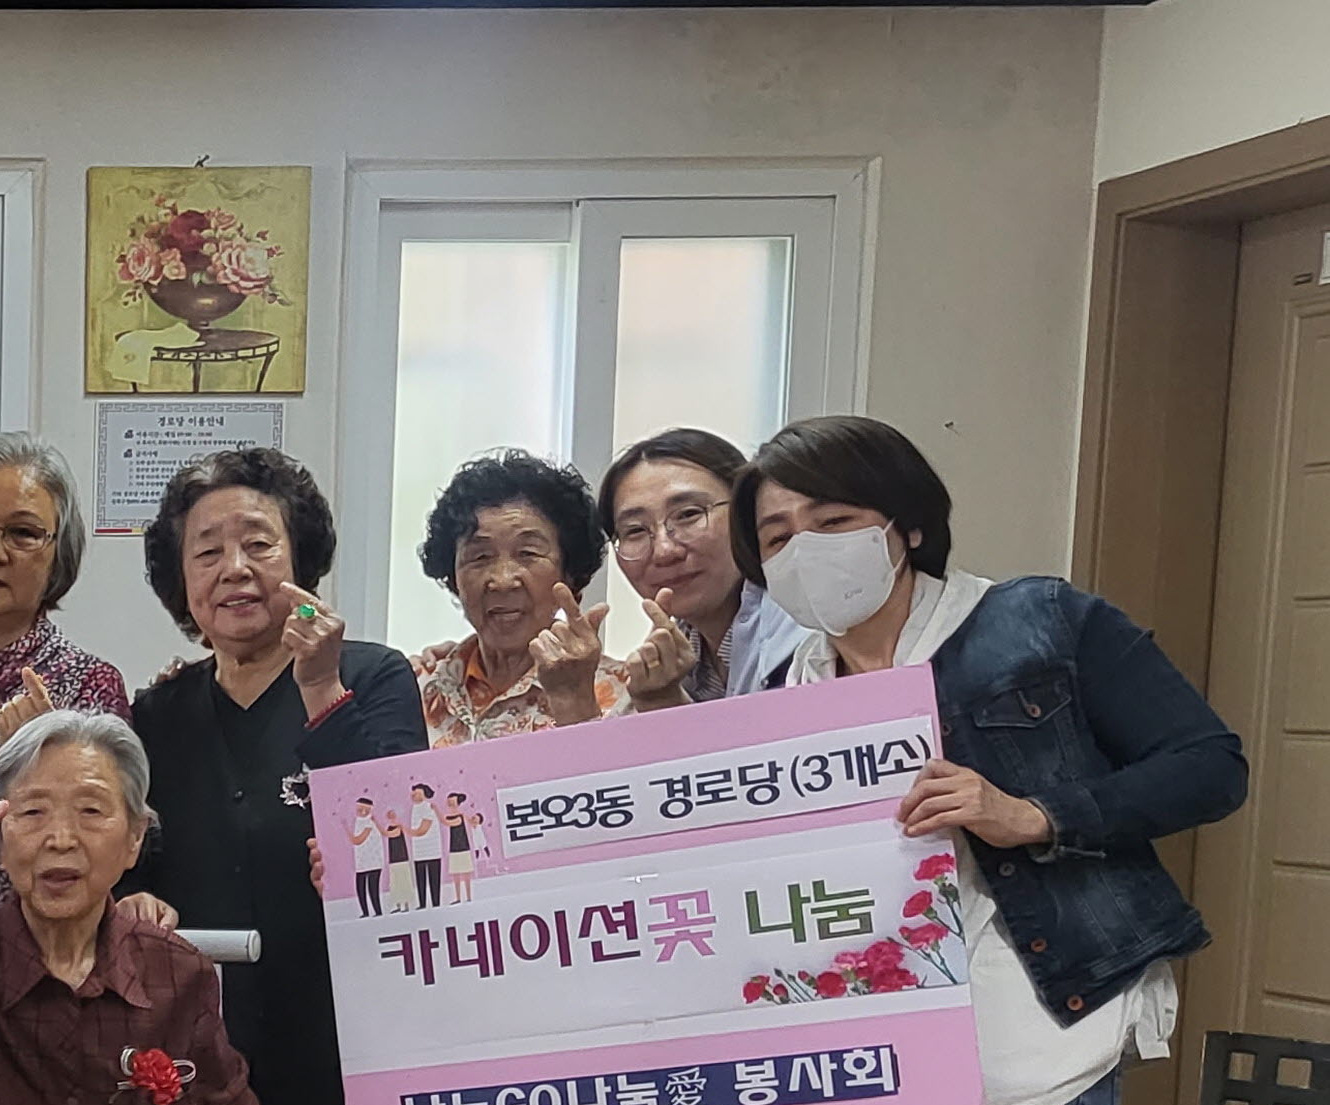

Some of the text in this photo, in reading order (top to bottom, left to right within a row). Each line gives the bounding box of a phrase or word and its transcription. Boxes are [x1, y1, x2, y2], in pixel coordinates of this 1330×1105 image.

[188, 416, 225, 427] 이용안내
[505, 784, 635, 843] 본오3동
[379, 879, 876, 986] 카네이션꽃 나눔
